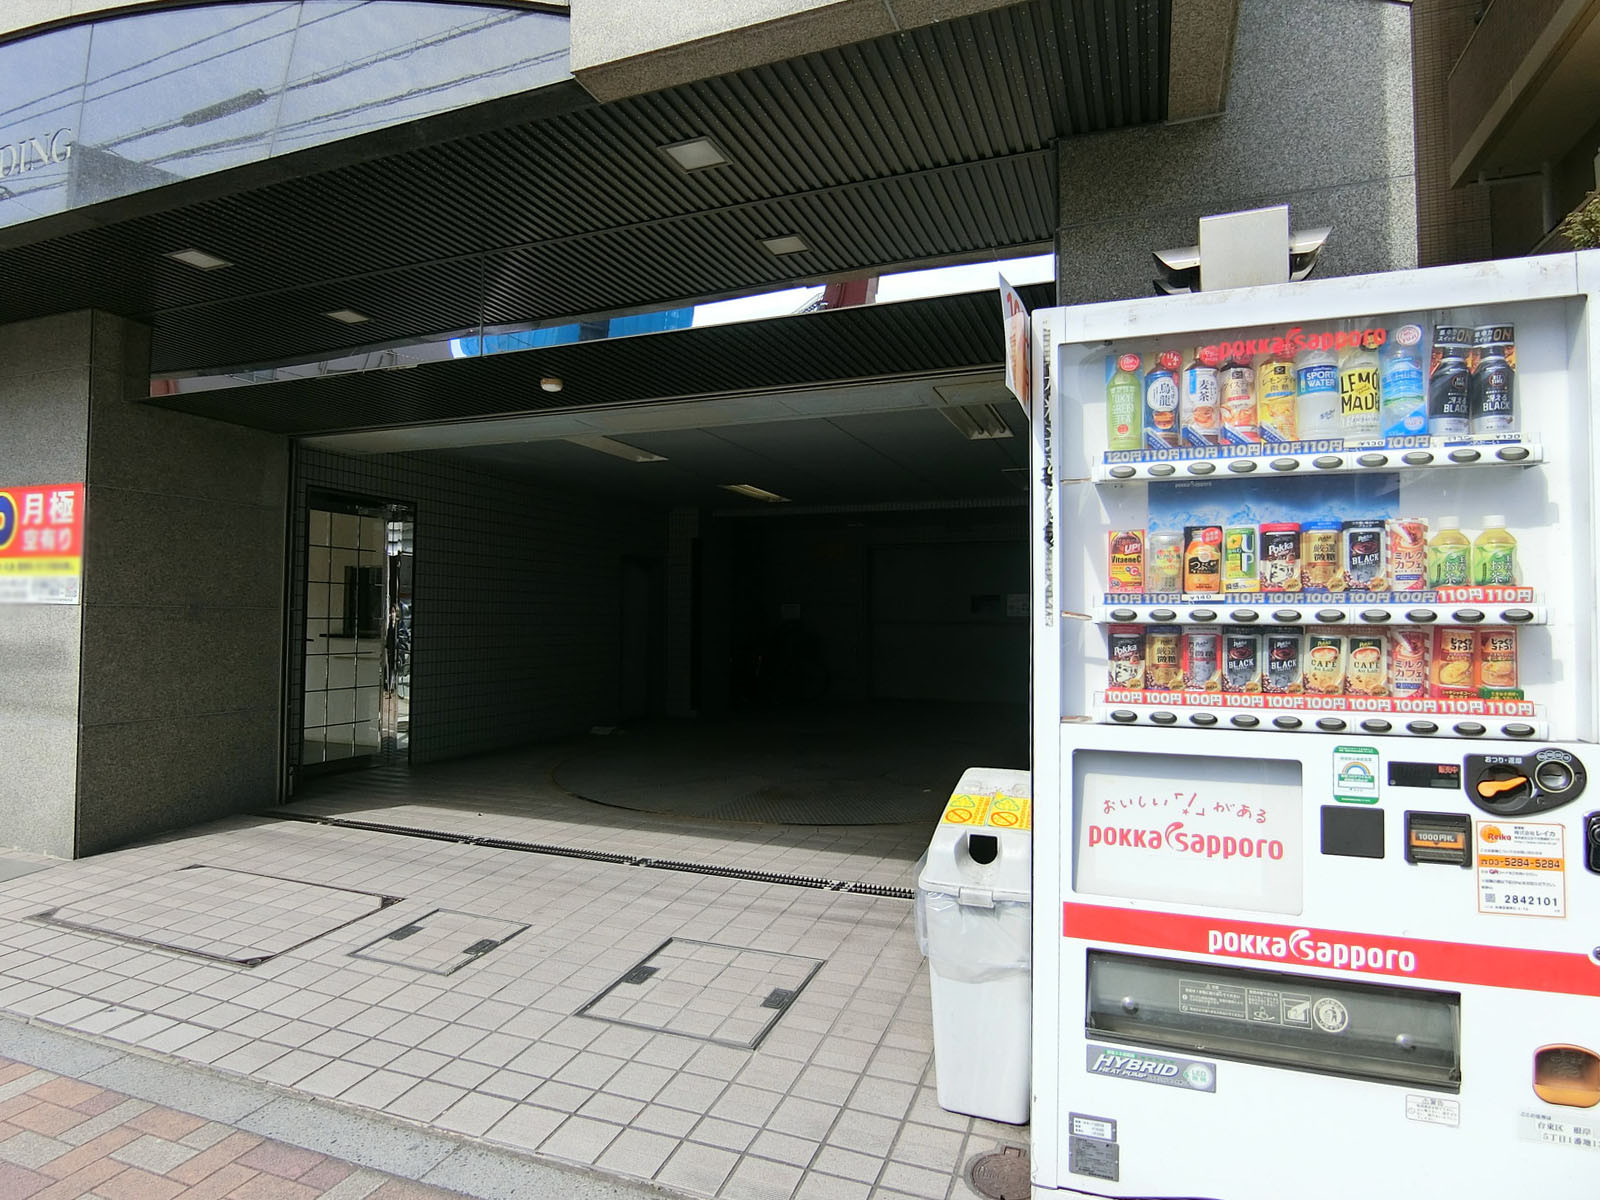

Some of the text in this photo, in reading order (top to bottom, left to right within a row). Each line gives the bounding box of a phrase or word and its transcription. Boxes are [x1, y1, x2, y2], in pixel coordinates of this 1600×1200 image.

[1493, 328, 1512, 341] ON
[1307, 379, 1335, 388] WATER
[1199, 379, 1209, 402] 麦茶
[1482, 401, 1509, 412] BLACK
[1387, 435, 1430, 449] 100円
[1106, 449, 1142, 464] 120円
[1143, 448, 1180, 462] 110円
[1180, 446, 1219, 460] 110円
[1221, 443, 1261, 458] 110円
[22, 490, 75, 526] 月極
[1269, 542, 1294, 556] Pokka
[1136, 555, 1142, 563] C
[1352, 553, 1380, 566] BLACK
[1395, 552, 1424, 561] ミルク
[1395, 561, 1423, 569] カフェ
[1446, 561, 1458, 585] お茶
[1491, 561, 1503, 584] お茶
[1106, 593, 1142, 604] 110円
[1144, 593, 1180, 604] 110円
[1225, 593, 1263, 604] 110円
[1305, 592, 1345, 604] 100円
[1348, 592, 1390, 603] 100円
[1392, 591, 1437, 603] 100円
[1440, 589, 1483, 602] 110円
[1486, 588, 1534, 602] 110円
[1114, 644, 1138, 656] Pokka
[1229, 659, 1255, 669] BLACK
[1271, 659, 1297, 670] BLACK
[1395, 660, 1423, 668] ミルク
[1395, 669, 1422, 678] カフェ
[1107, 691, 1142, 703] 100円
[1145, 692, 1182, 704] 100円
[1184, 693, 1222, 705] 100円
[1224, 694, 1263, 706] 100円
[1266, 695, 1304, 707] 100円
[1306, 696, 1346, 709] 100円
[1350, 698, 1391, 711] 100円
[1394, 699, 1438, 712] 100円
[1440, 700, 1484, 713] 110円
[1486, 701, 1534, 715] 110円
[1488, 857, 1561, 869] 03-5284-5284
[1504, 894, 1557, 907] 2842101
[1092, 1053, 1179, 1077] HYBRID
